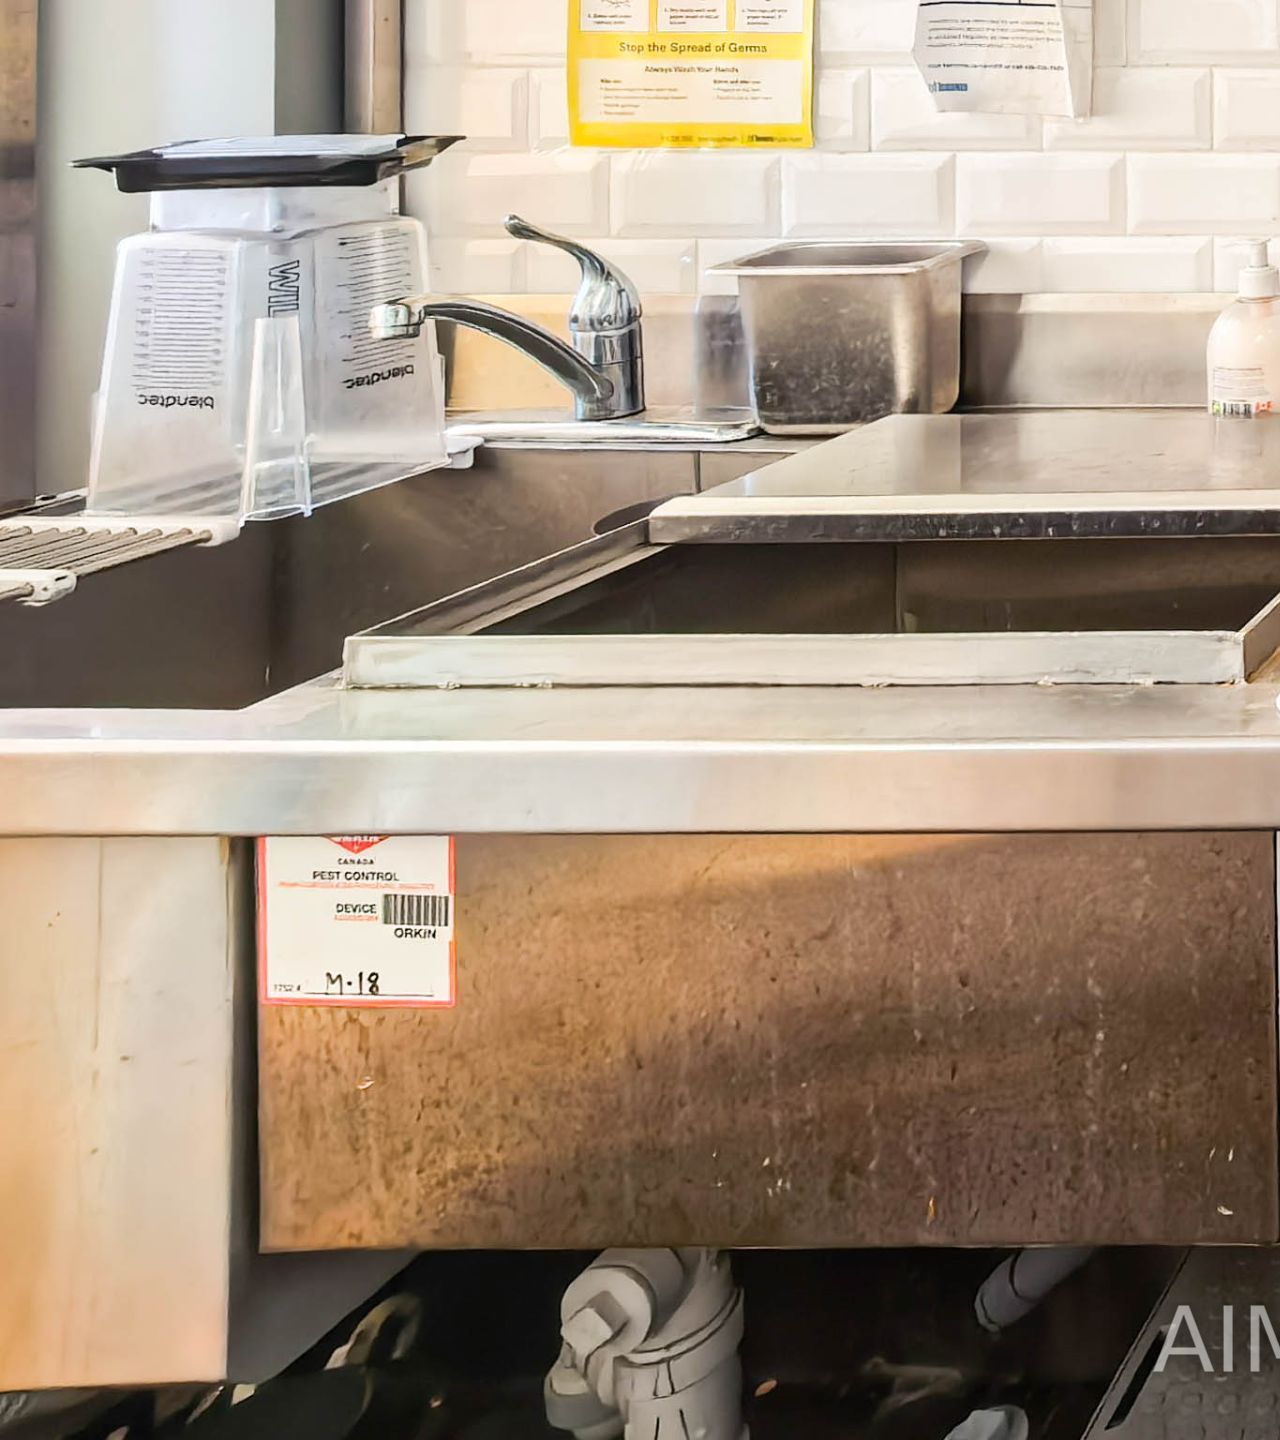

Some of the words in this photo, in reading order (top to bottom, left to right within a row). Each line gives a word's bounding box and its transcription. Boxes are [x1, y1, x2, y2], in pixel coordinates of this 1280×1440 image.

[619, 42, 644, 56] Stop
[647, 42, 666, 53] the
[670, 42, 712, 56] Spread
[715, 42, 726, 53] of
[728, 42, 767, 53] Germs
[268, 259, 300, 318] WIL
[343, 364, 415, 390] blendtec
[138, 394, 214, 409] blendtec
[313, 871, 341, 880] PEST
[344, 871, 399, 881] CONTROL
[335, 903, 377, 914] DEVICE
[394, 927, 437, 939] ORKIN
